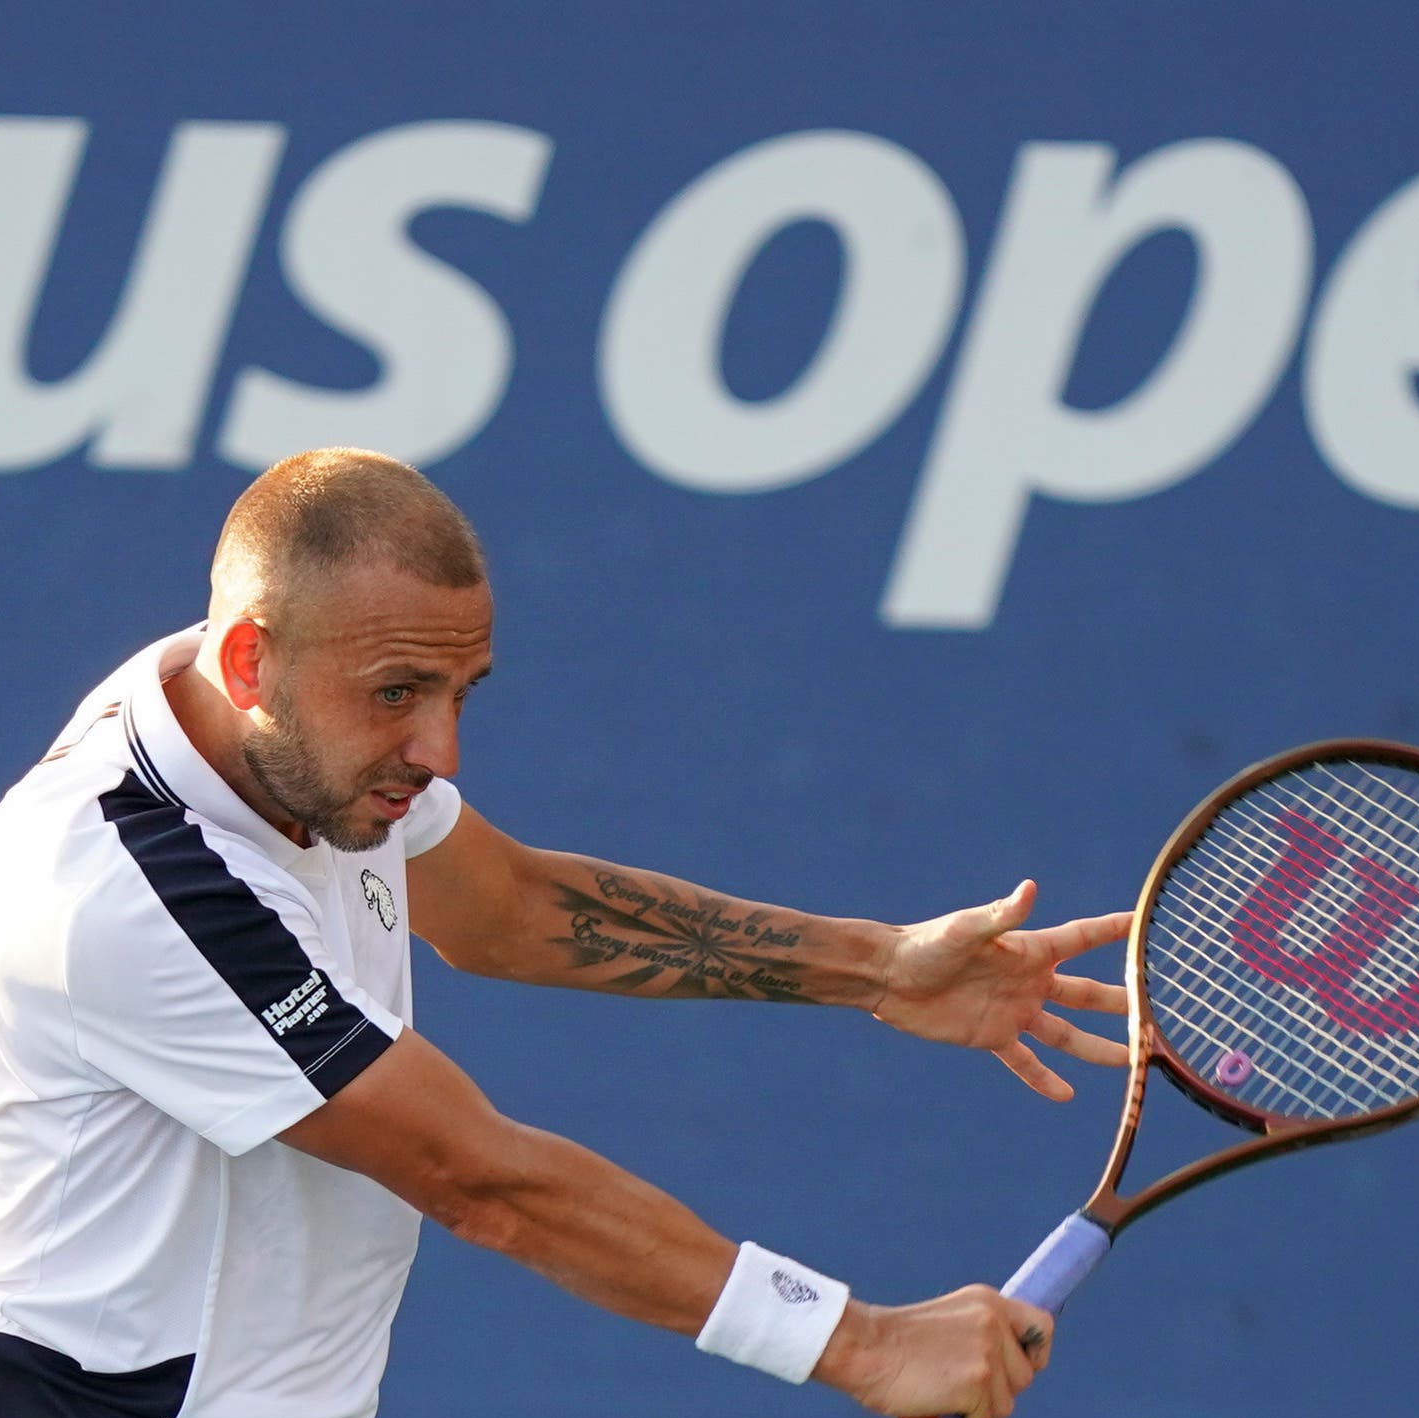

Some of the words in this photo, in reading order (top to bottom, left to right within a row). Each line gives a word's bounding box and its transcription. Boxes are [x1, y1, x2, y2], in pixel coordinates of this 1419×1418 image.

[595, 871, 659, 917] Every
[571, 911, 630, 962] Every
[261, 969, 323, 1026] Hotel
[272, 984, 328, 1036] Planner
[306, 1002, 329, 1026] .com
